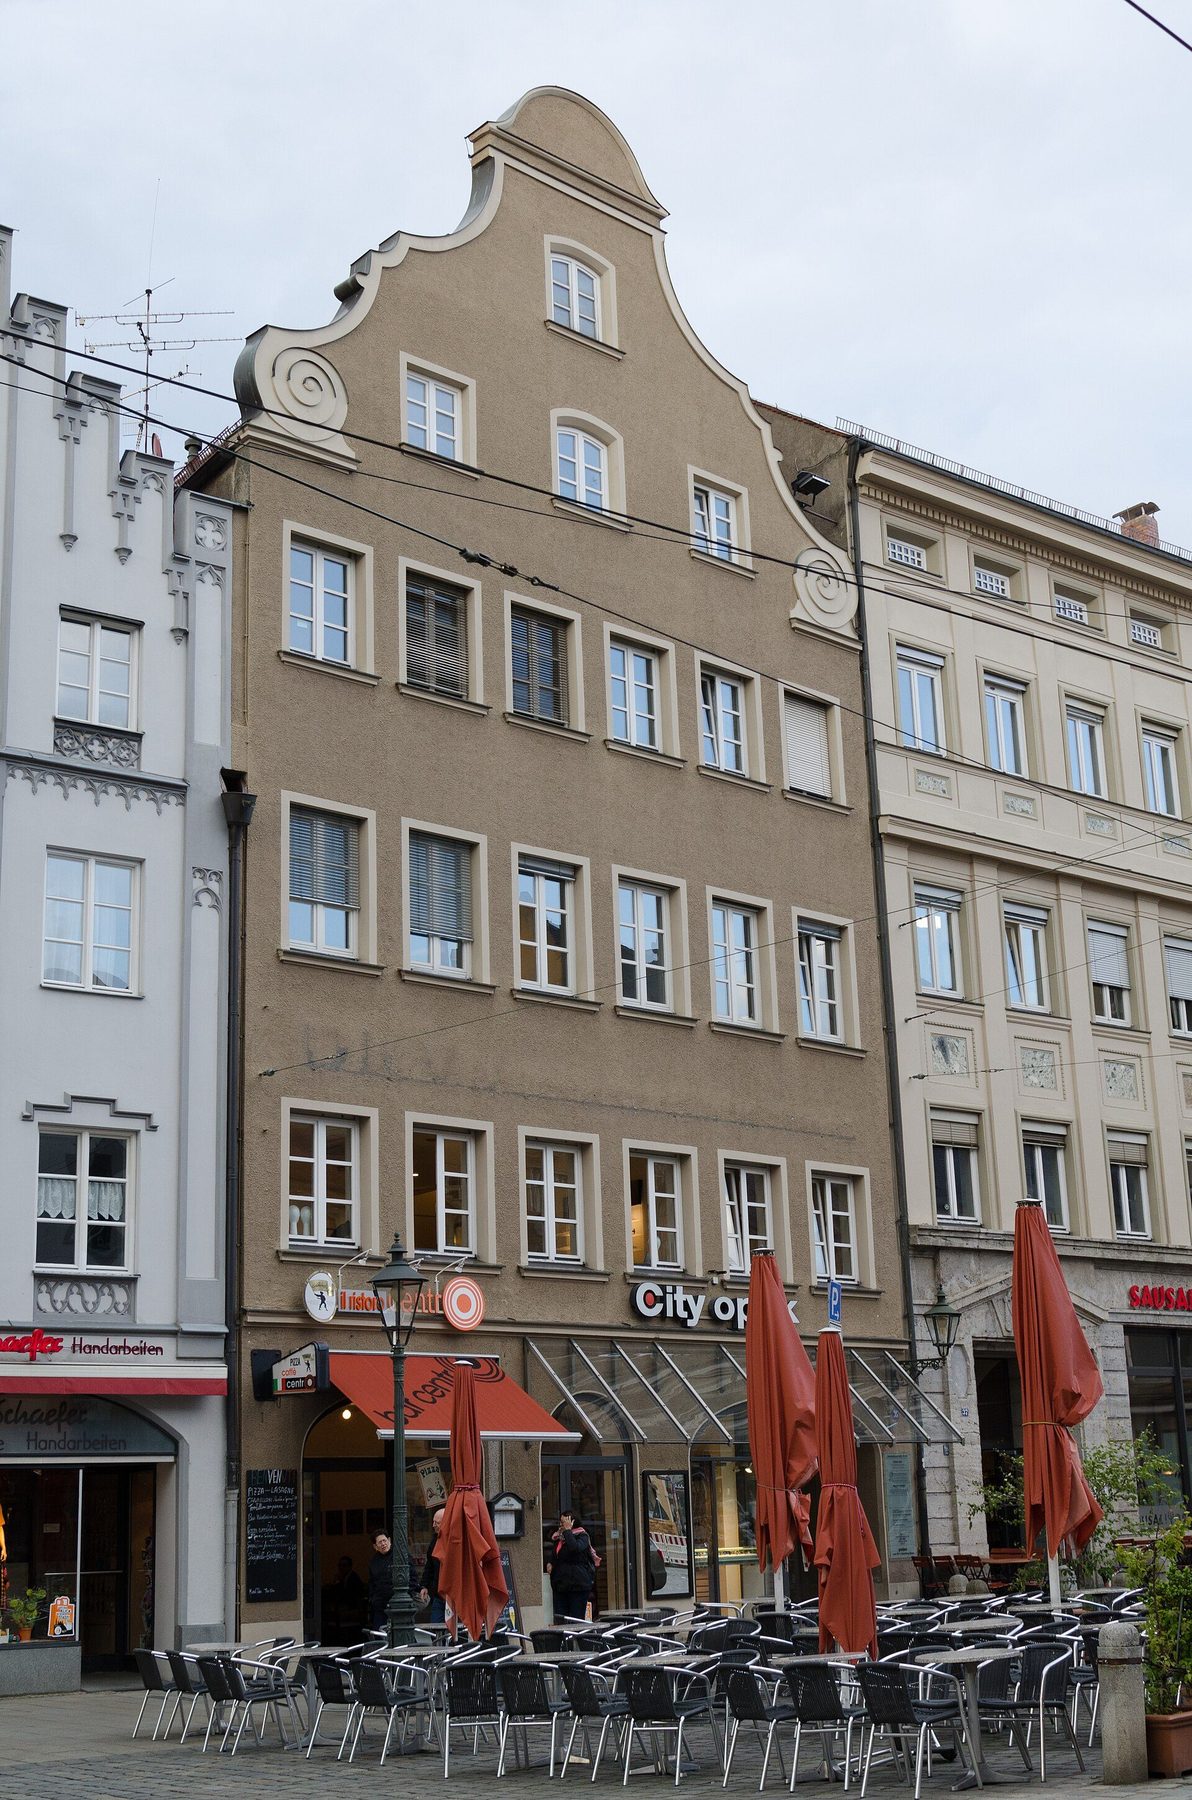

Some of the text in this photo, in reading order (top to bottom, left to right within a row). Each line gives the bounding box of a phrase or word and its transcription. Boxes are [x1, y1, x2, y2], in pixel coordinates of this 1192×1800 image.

[350, 1291, 387, 1312] ristoro
[632, 1282, 800, 1330] City opk
[831, 1286, 839, 1316] P
[0, 1329, 164, 1361] aefer Handarbeiten
[26, 1431, 127, 1451] Handarbeiten
